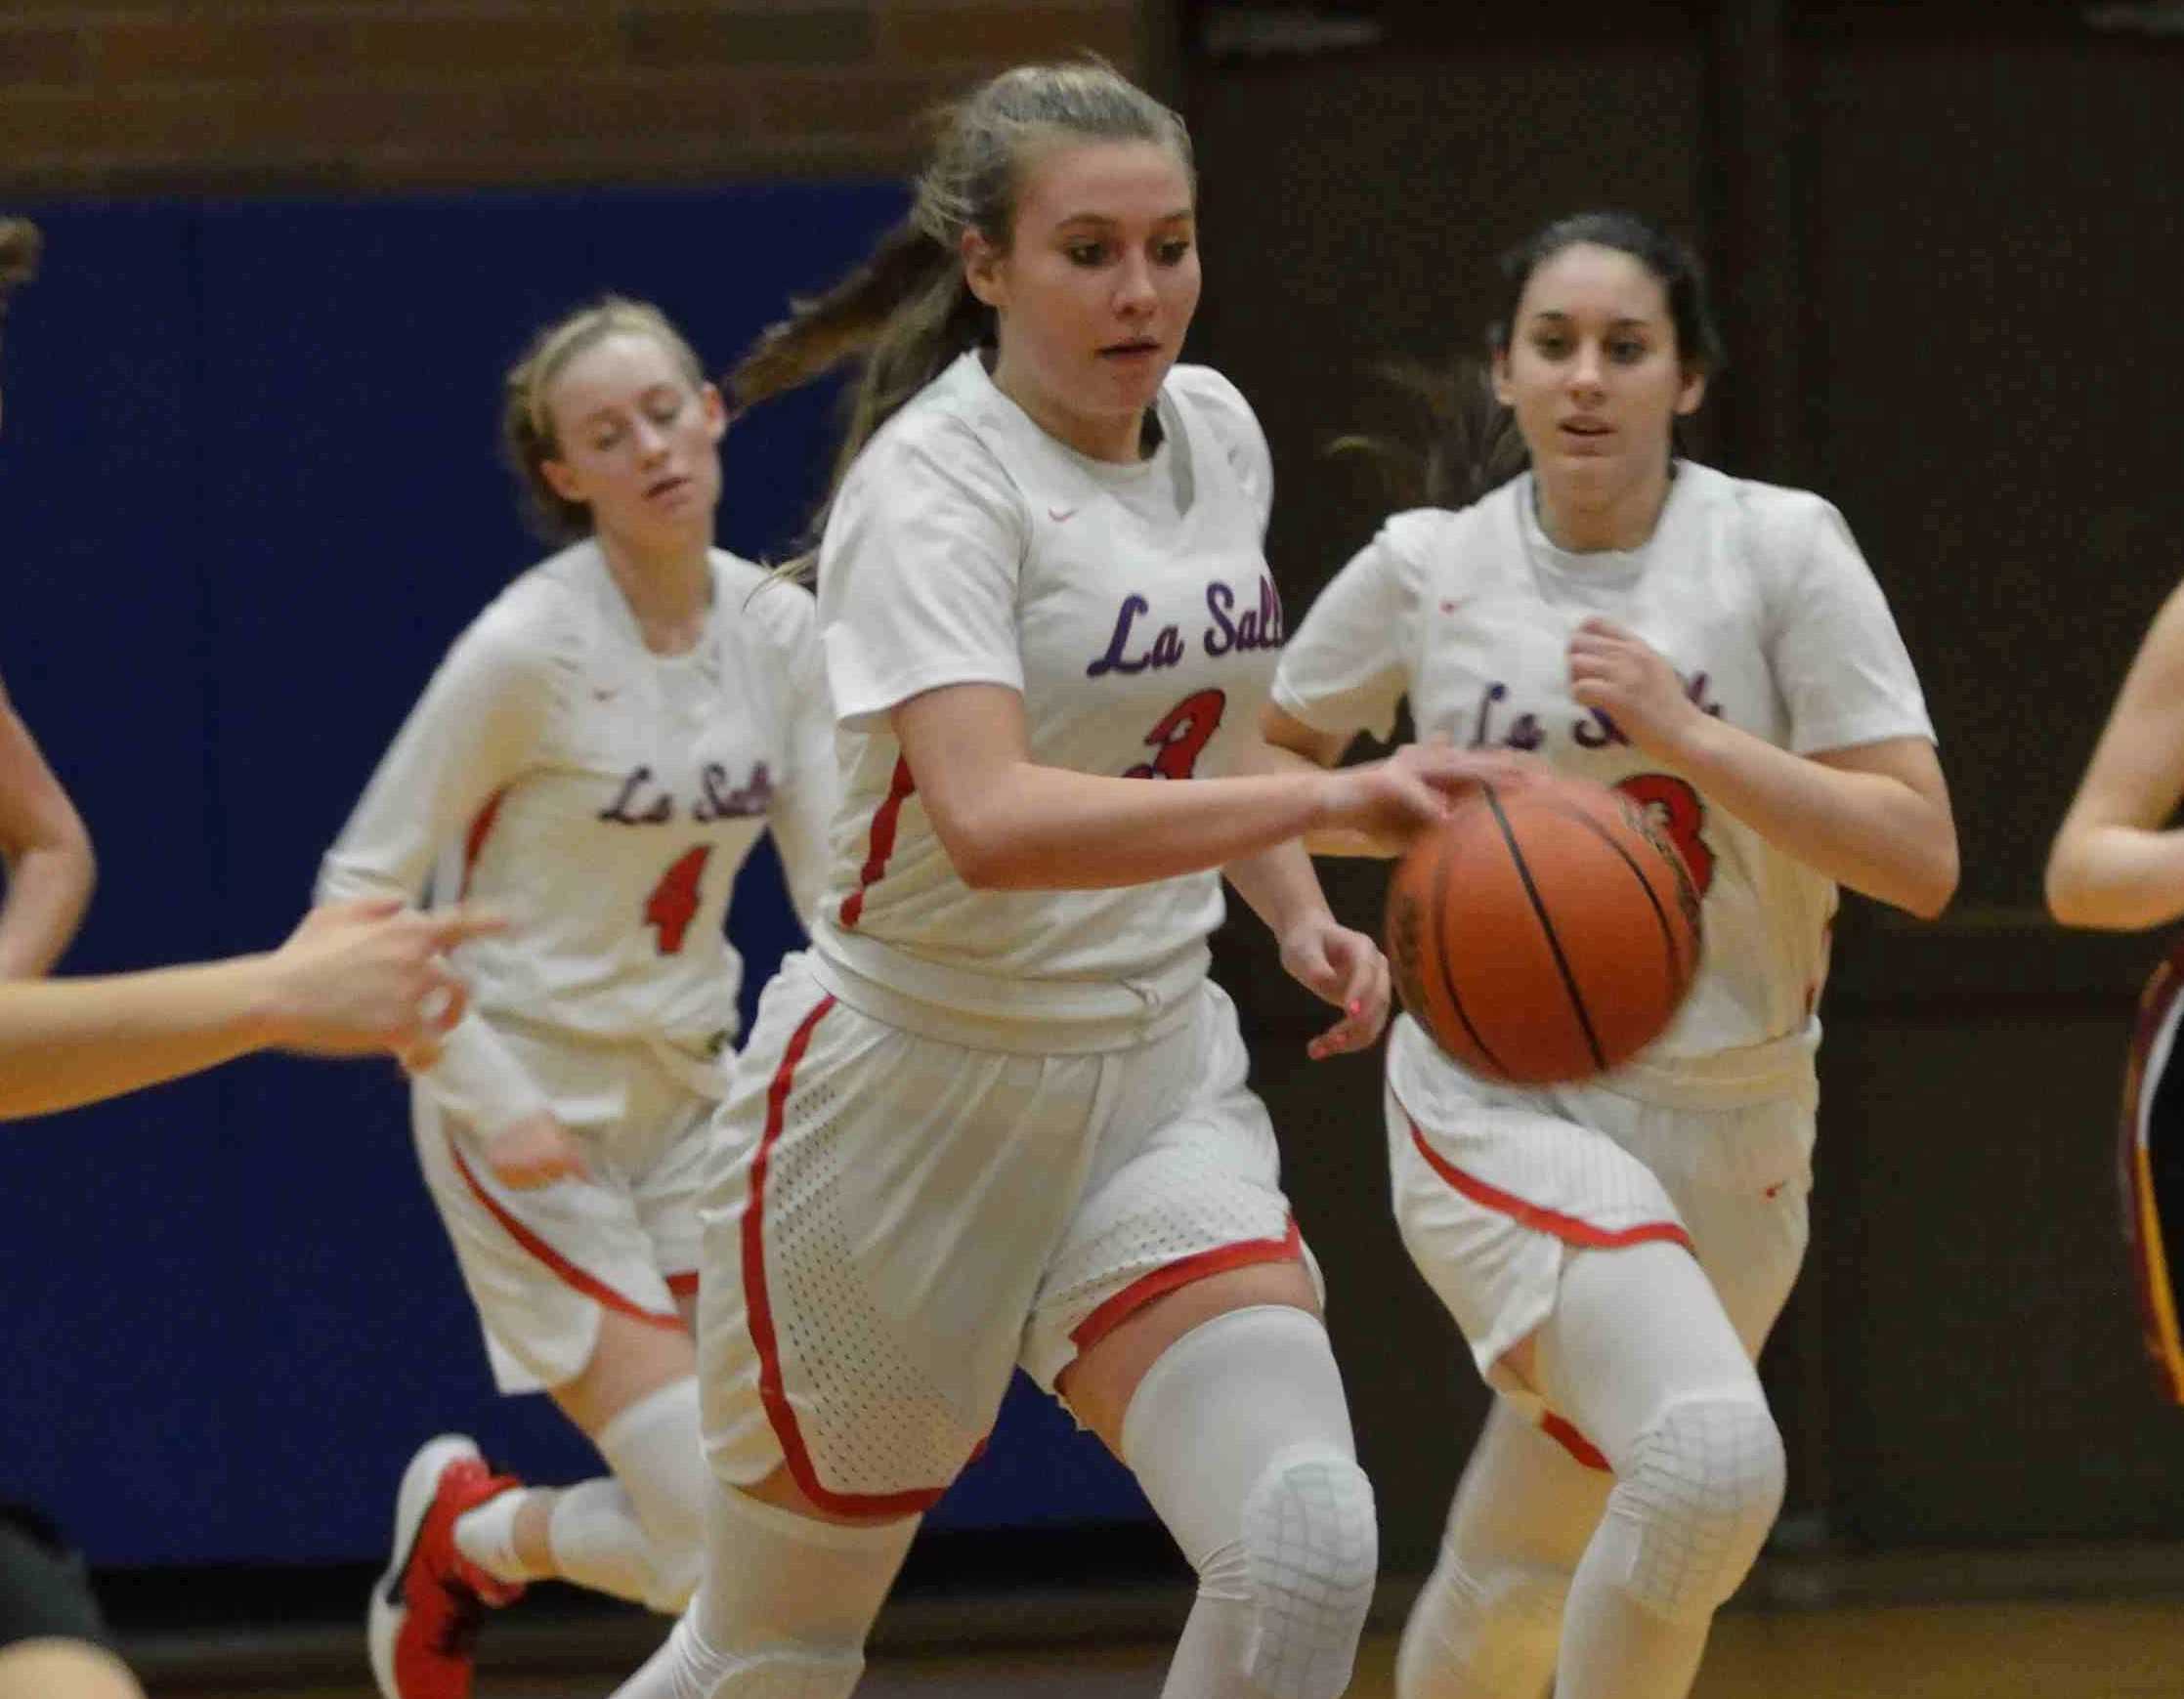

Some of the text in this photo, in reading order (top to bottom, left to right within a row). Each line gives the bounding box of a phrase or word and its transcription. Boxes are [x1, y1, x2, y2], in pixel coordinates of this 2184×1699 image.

[1086, 573, 1284, 677] La Sall
[643, 842, 715, 956] 4
